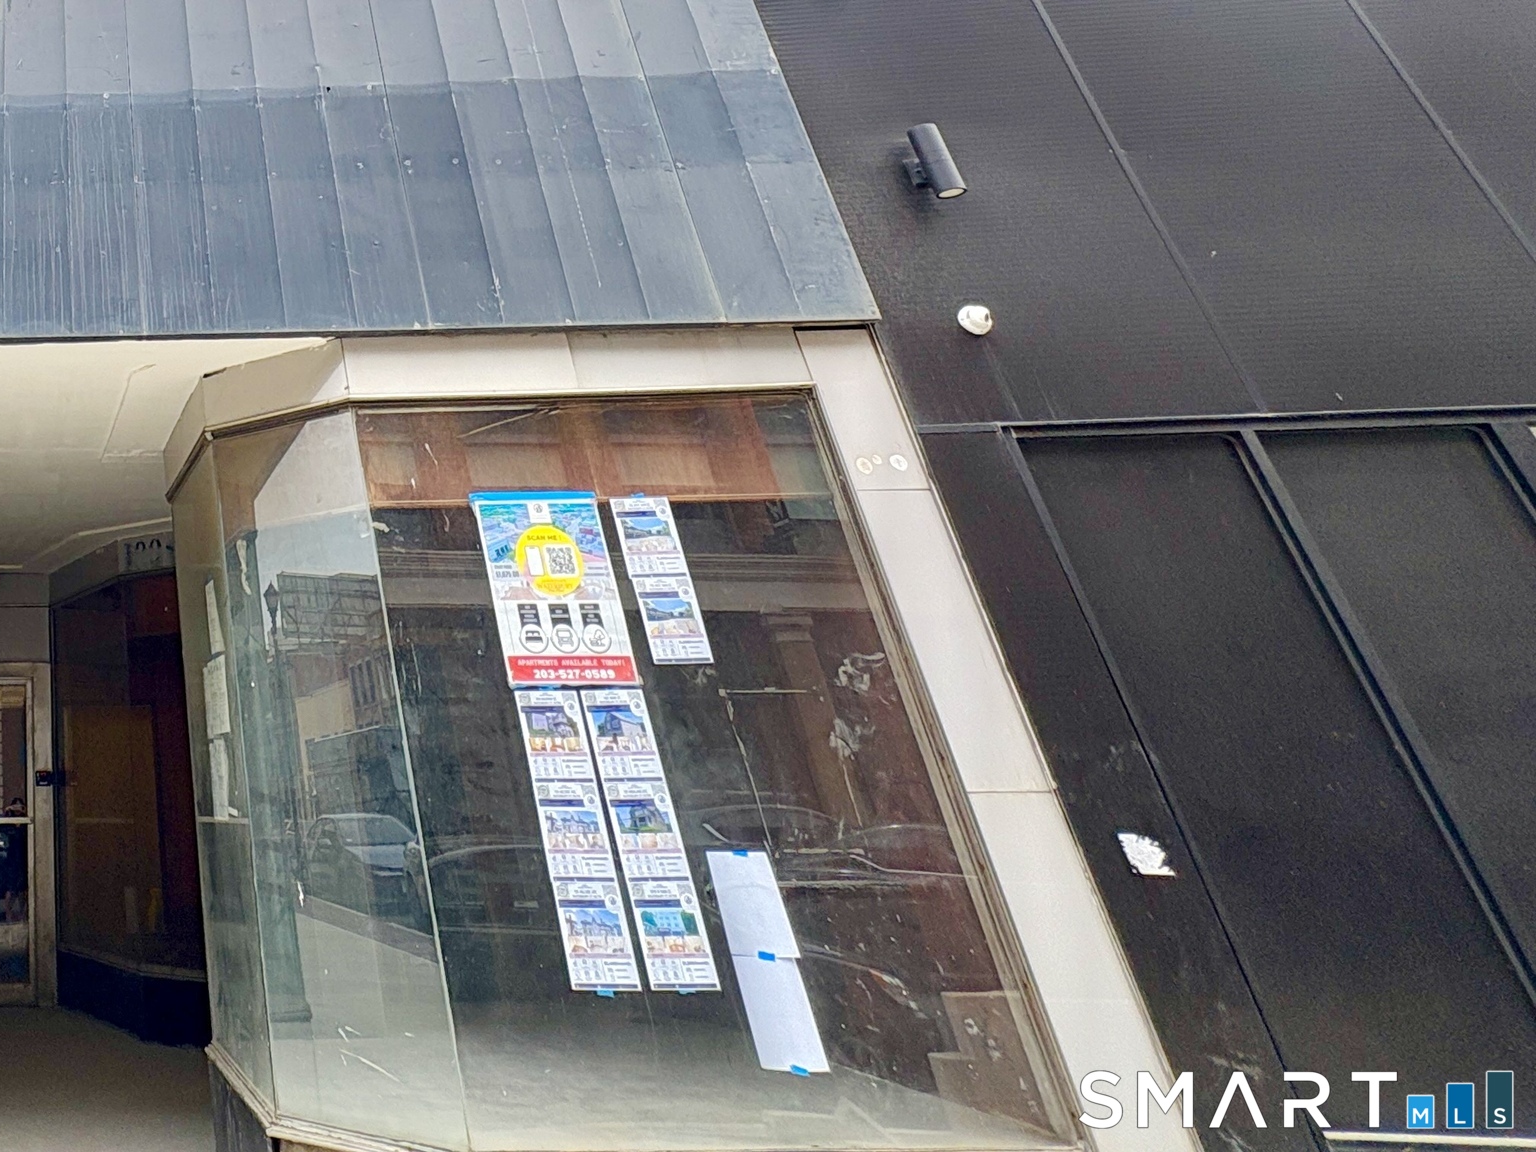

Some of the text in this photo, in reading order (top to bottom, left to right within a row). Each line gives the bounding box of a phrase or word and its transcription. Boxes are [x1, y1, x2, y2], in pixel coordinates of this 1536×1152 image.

[517, 658, 626, 667] APARTMENTS AVAILABLE TODAY!
[533, 669, 616, 680] 203-527-0589
